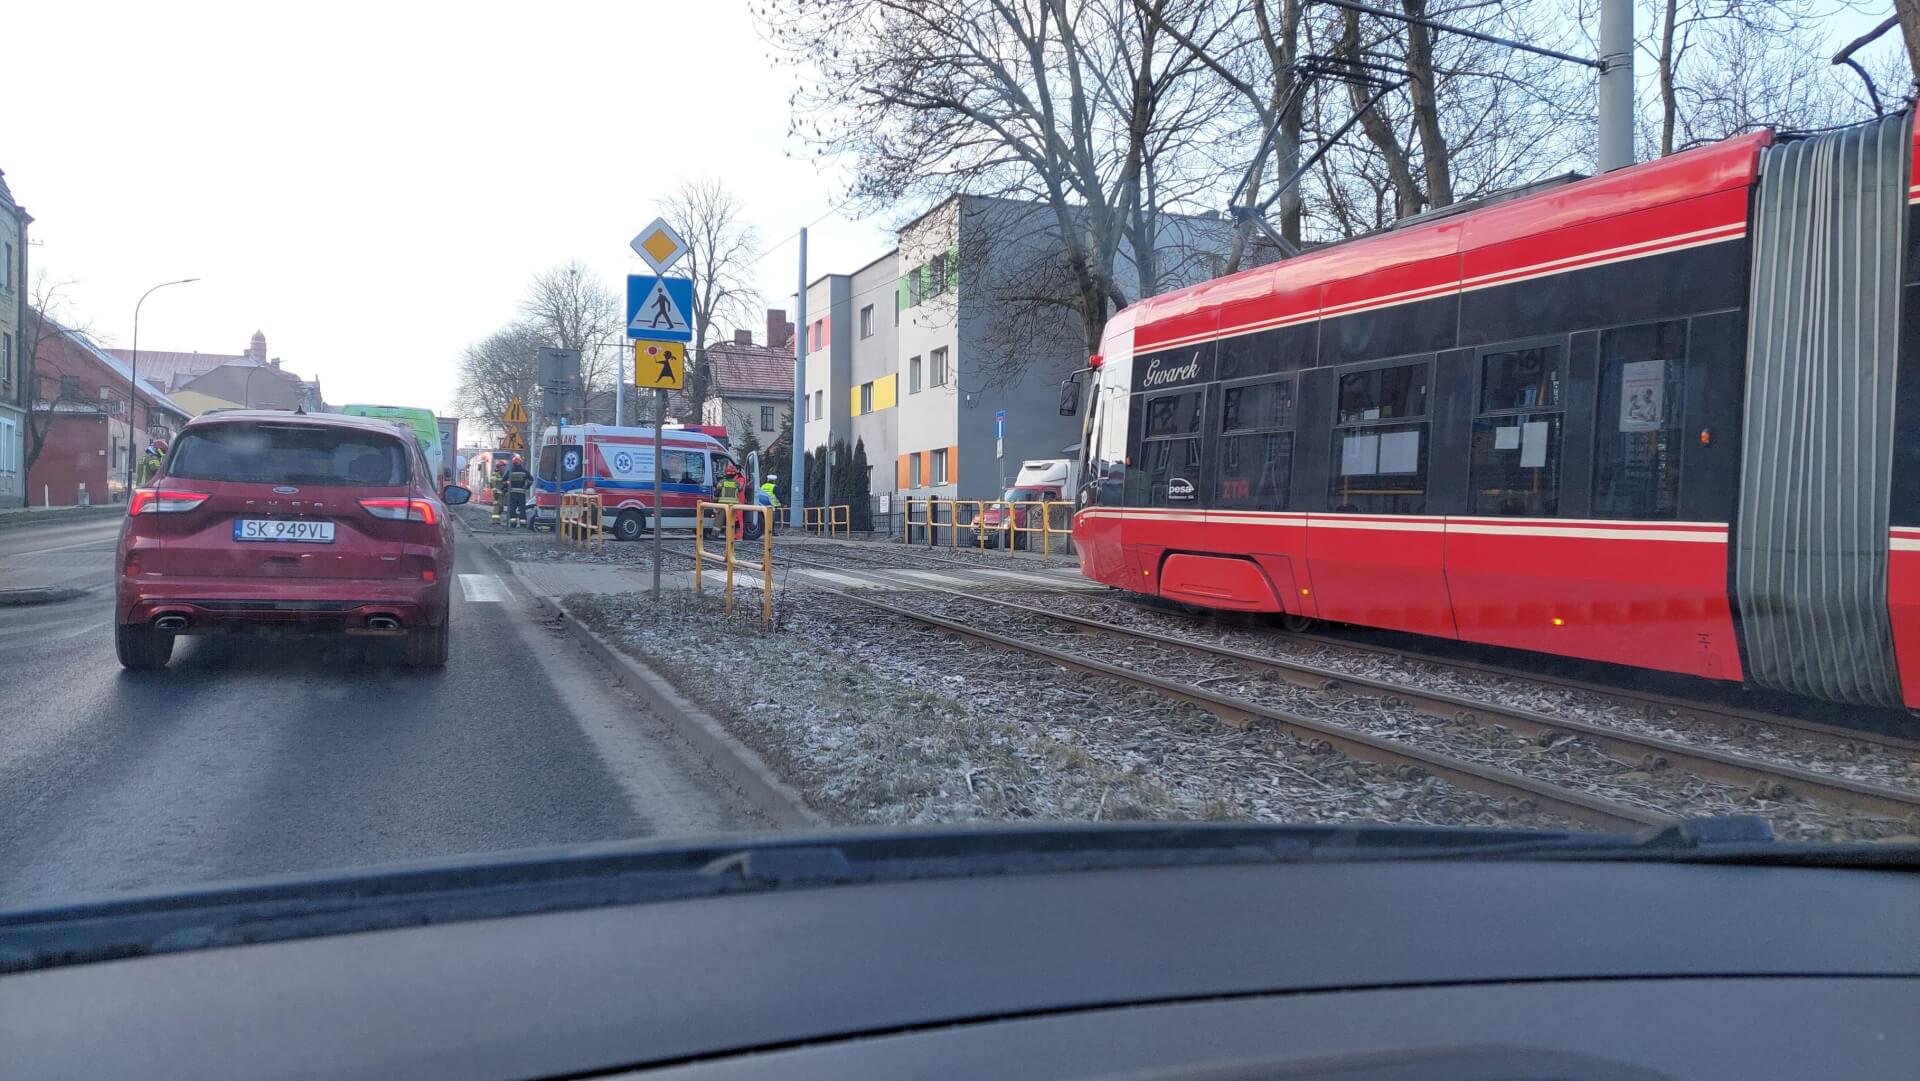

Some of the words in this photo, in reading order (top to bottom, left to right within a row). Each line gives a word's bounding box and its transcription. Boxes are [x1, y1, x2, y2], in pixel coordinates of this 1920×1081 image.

[1143, 351, 1200, 387] Gwarek
[1168, 485, 1192, 495] pesa
[246, 521, 268, 537] SK
[275, 522, 329, 539] 949VL
